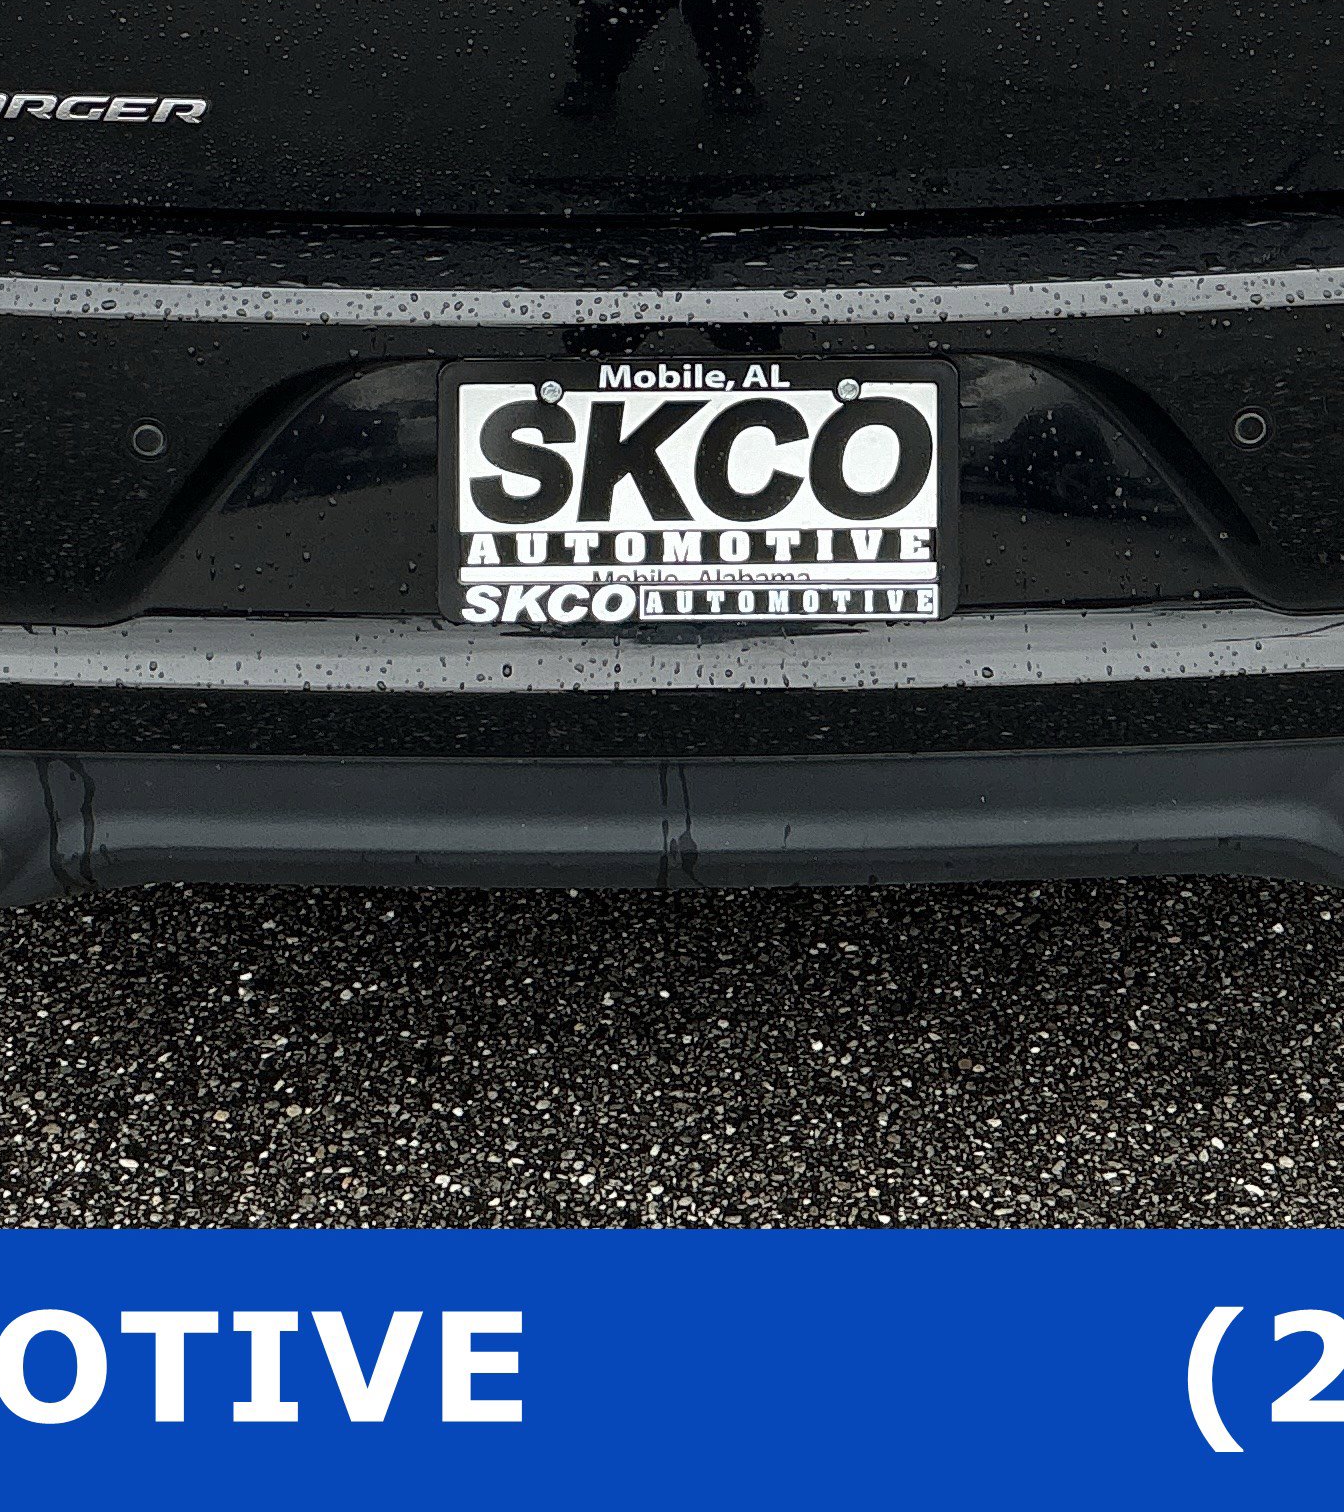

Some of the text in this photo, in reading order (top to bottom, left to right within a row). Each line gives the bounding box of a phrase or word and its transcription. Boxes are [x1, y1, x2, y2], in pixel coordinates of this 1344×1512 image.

[599, 364, 791, 392] Mobile, AL
[469, 395, 933, 525] SKCO
[467, 529, 932, 566] AUTOMOTIVE
[461, 584, 934, 623] SKCO AUTOMOTIVE
